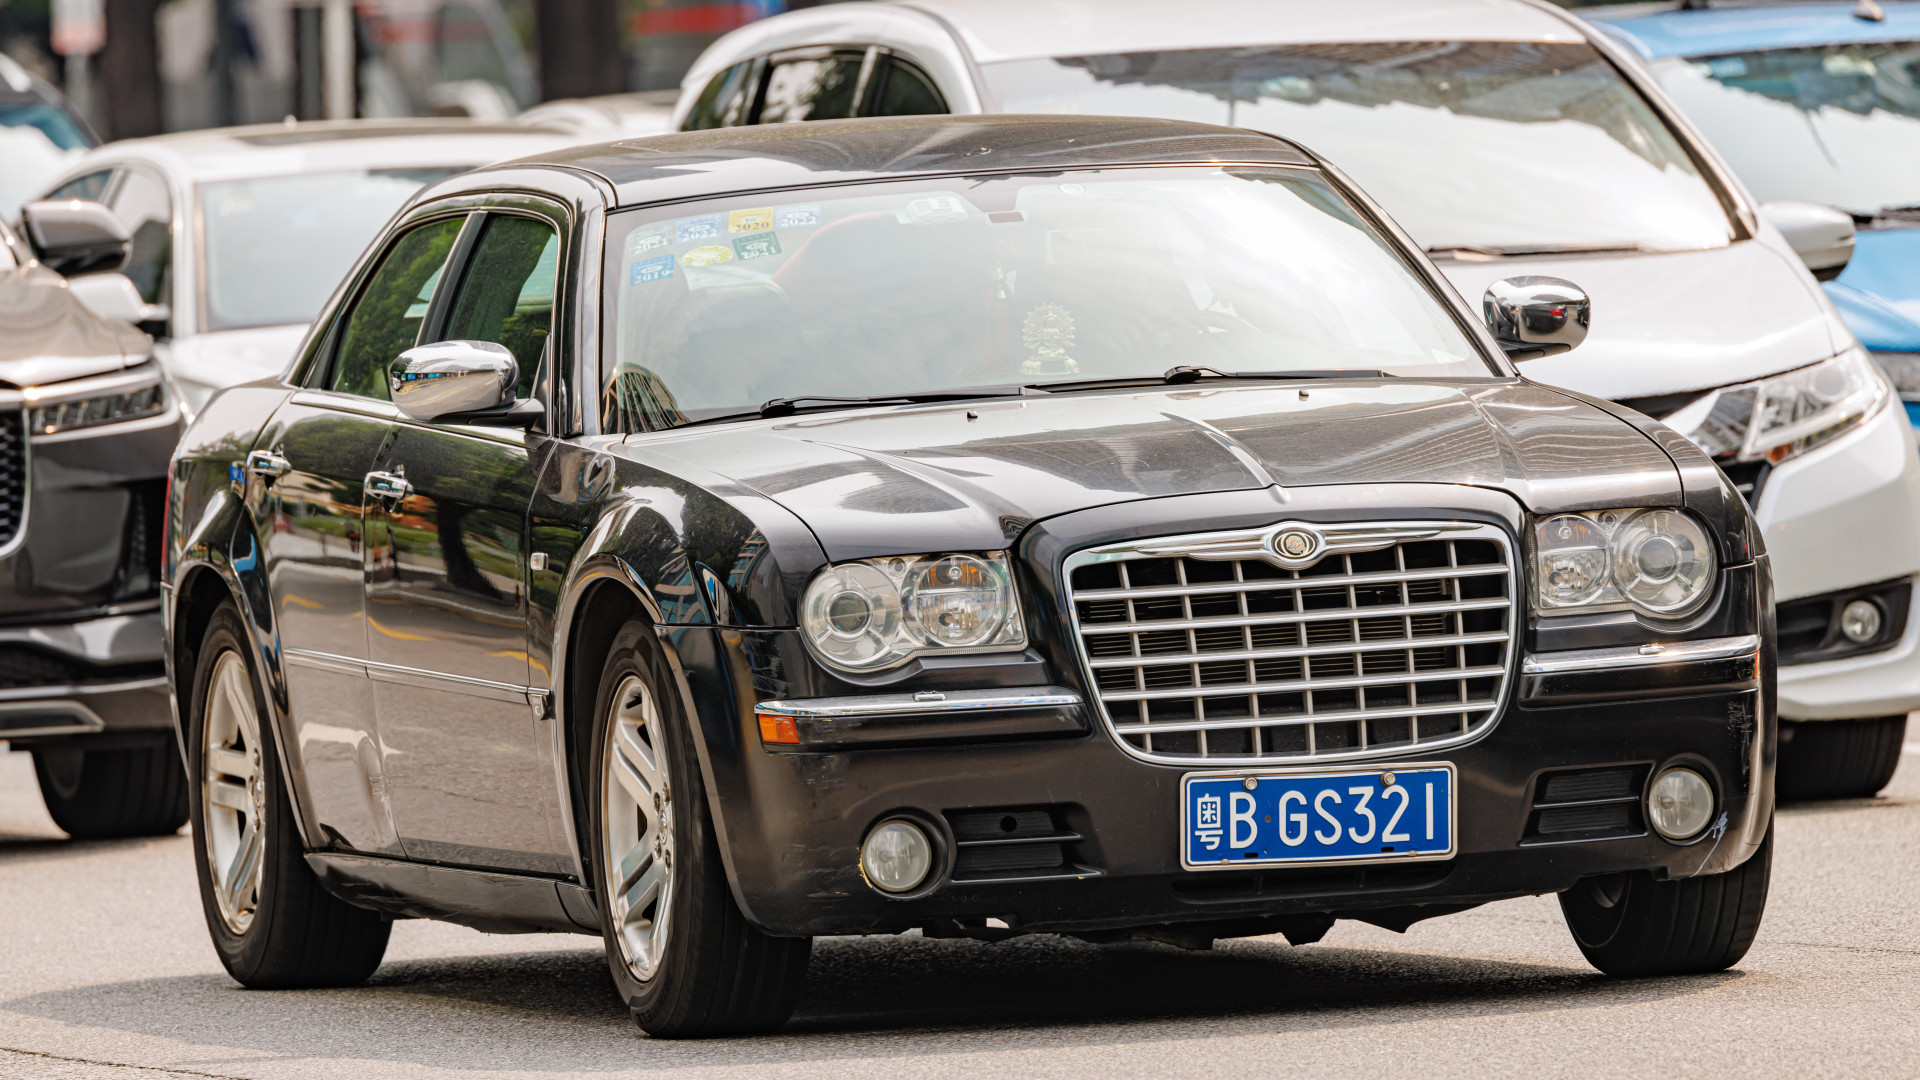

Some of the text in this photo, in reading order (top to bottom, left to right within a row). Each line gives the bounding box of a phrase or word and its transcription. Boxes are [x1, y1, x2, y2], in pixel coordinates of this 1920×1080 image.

[734, 221, 770, 232] 2020
[780, 216, 817, 227] 2022
[681, 227, 718, 242] 2022
[741, 246, 776, 260] 2021
[634, 269, 670, 284] 2019
